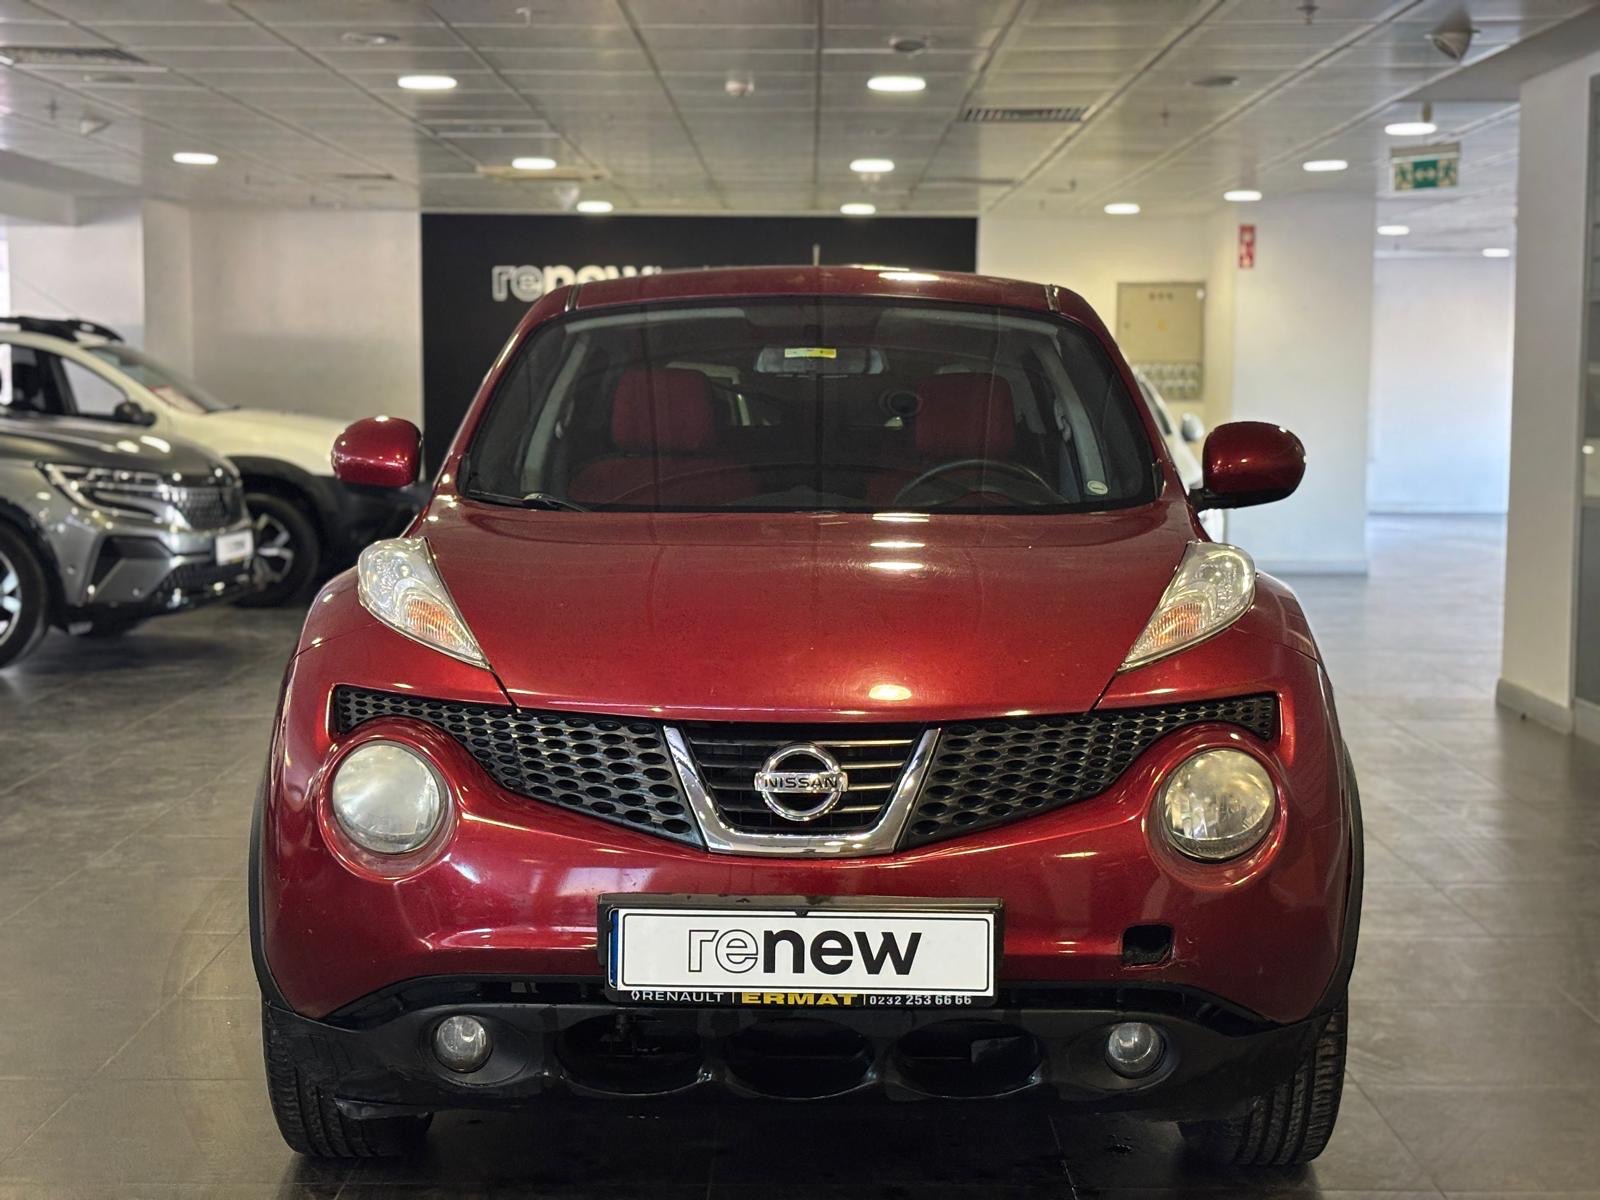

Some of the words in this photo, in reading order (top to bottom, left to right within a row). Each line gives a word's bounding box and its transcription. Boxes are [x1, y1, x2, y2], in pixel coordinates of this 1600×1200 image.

[764, 777, 838, 789] NISSAN
[688, 928, 922, 975] renew
[642, 990, 724, 1003] RENAULT
[741, 992, 858, 1006] ERMAT
[869, 995, 902, 1005] 0232
[905, 994, 932, 1005] 253
[935, 995, 952, 1005] 66
[955, 995, 972, 1005] 66
